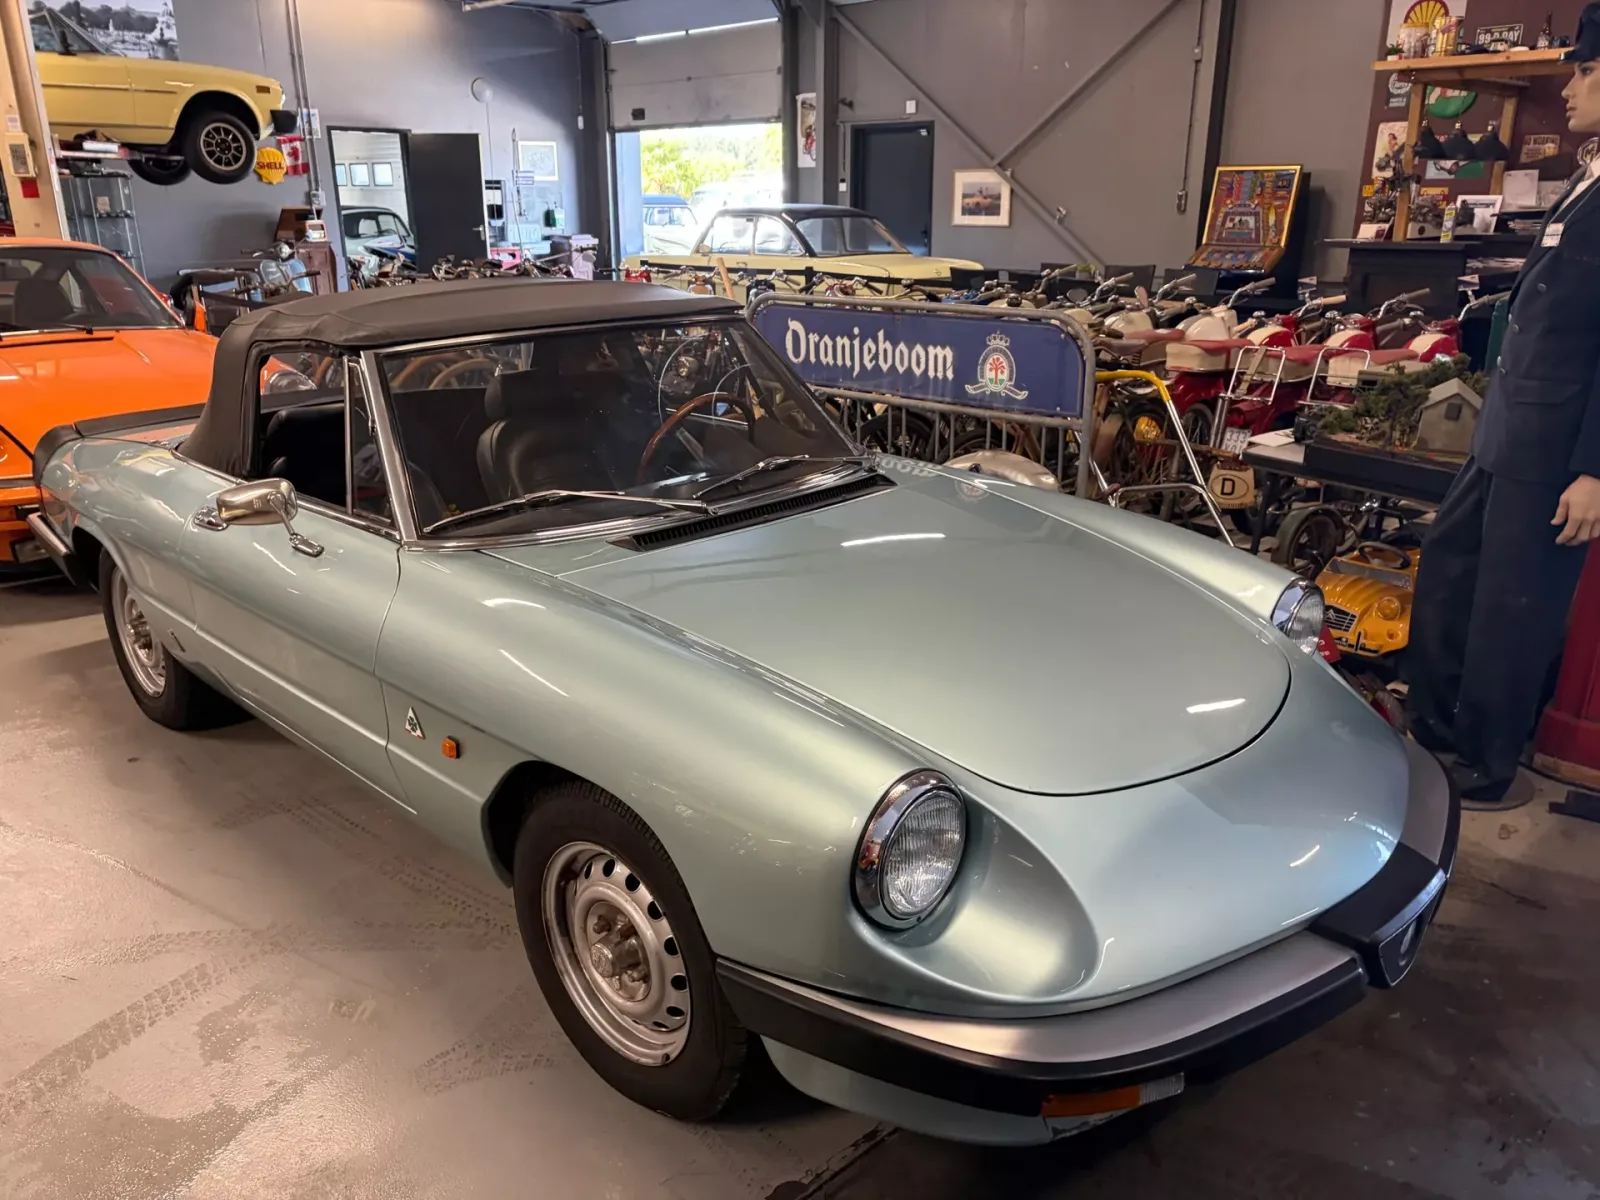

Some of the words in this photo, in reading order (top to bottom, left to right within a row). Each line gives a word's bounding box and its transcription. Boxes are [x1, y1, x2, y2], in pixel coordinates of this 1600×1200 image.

[257, 161, 285, 170] SHELL
[785, 317, 955, 381] Oranjeboom
[1227, 429, 1247, 444] 333
[1221, 477, 1236, 496] D
